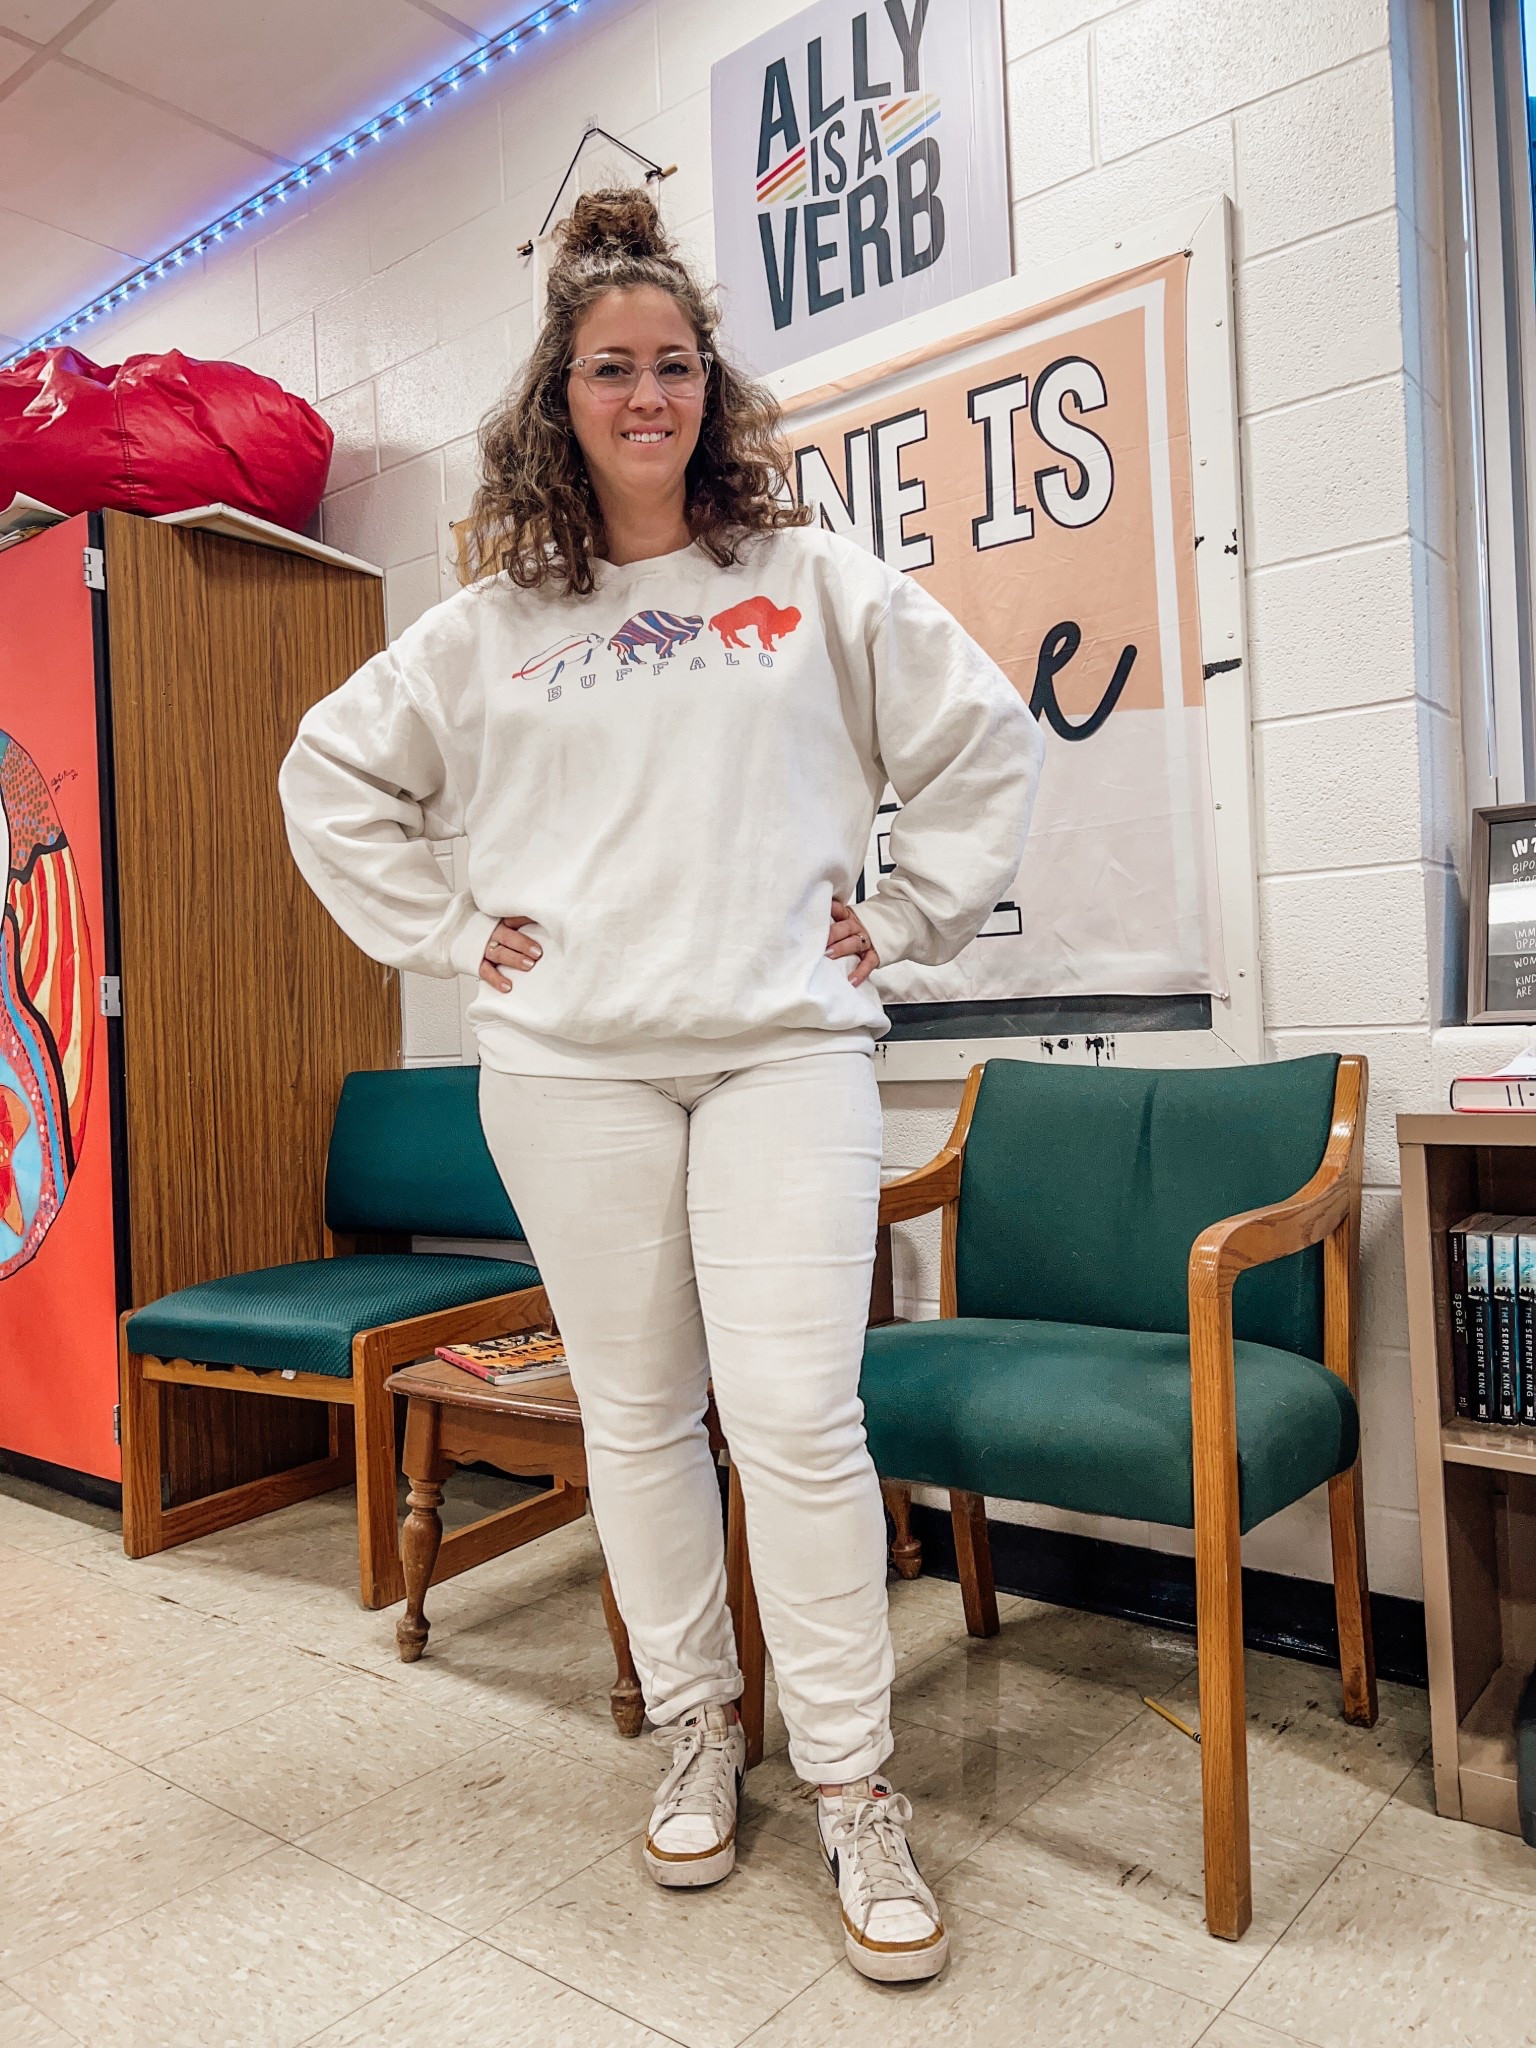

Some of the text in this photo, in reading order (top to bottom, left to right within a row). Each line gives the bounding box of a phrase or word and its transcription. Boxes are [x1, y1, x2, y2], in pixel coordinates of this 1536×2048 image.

[756, 0, 930, 178] ALLY
[810, 107, 882, 197] IS A
[757, 136, 946, 331] VERB
[793, 354, 1115, 573] NE IS
[547, 652, 774, 702] BUFFALO
[1511, 838, 1528, 858] IN
[1516, 985, 1532, 999] ARE
[1452, 1293, 1465, 1333] speak
[1476, 1327, 1484, 1369] SERPENT
[1501, 1327, 1510, 1370] SERPENT
[1525, 1328, 1533, 1371] SERPENT
[1502, 1372, 1511, 1397] KING
[1526, 1373, 1534, 1397] KING
